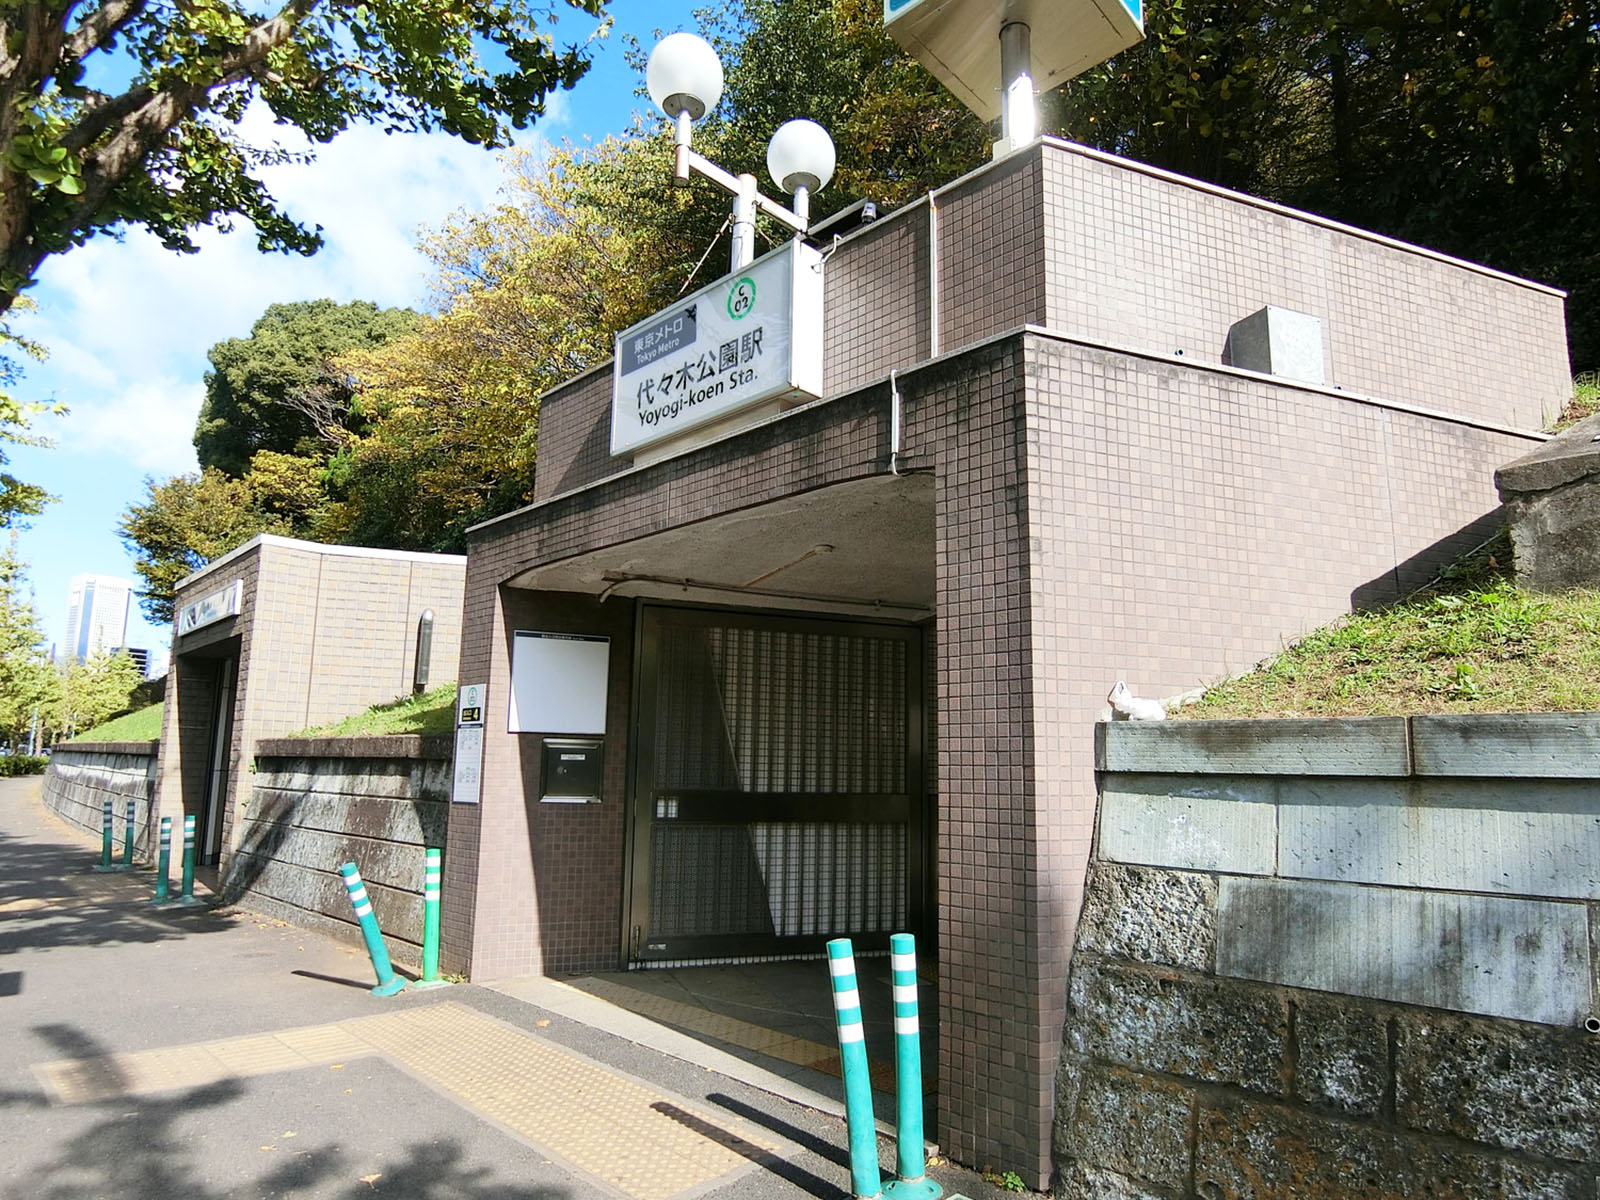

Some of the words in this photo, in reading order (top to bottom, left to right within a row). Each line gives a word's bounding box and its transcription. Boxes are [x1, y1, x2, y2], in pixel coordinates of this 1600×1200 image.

[734, 297, 749, 313] 02
[738, 285, 745, 297] C
[633, 317, 684, 355] 東京メトロ
[636, 346, 657, 365] Tokyo
[658, 337, 680, 356] Metro
[636, 326, 763, 409] 代々木公園駅
[638, 380, 724, 427] Yoyogi-koen
[729, 368, 758, 390] Sta.
